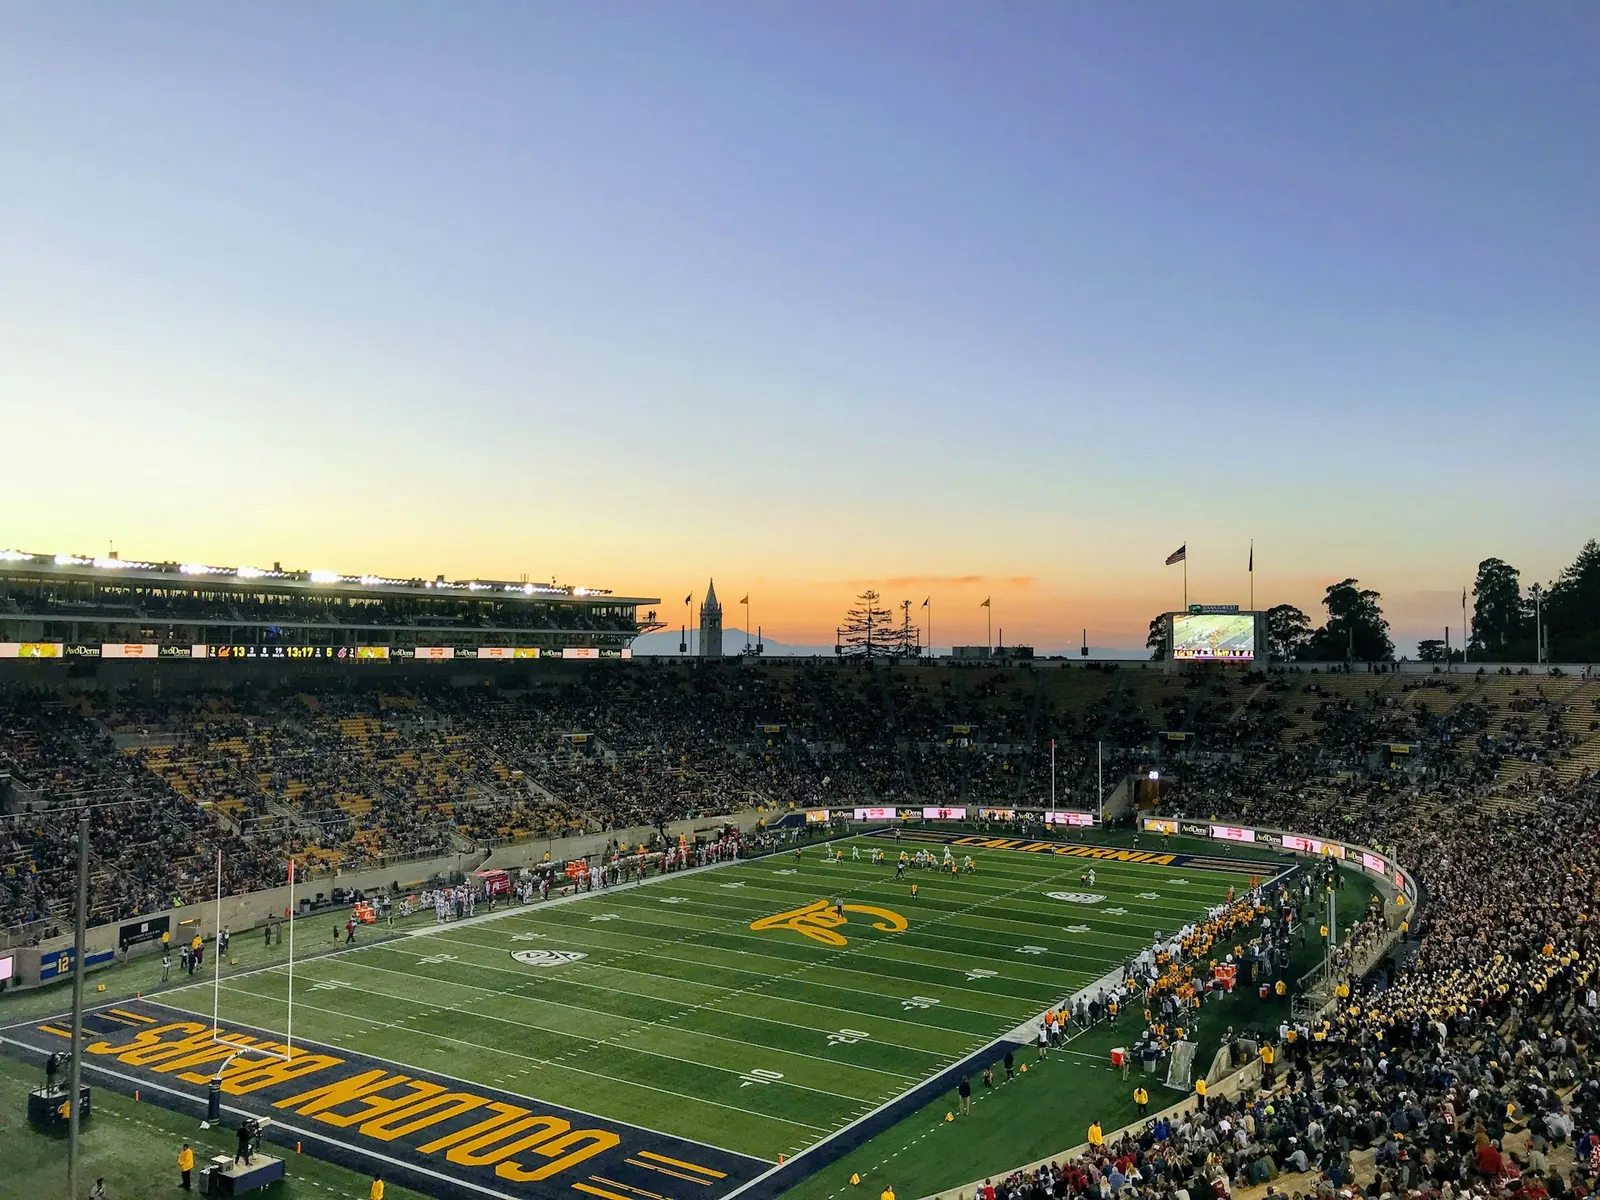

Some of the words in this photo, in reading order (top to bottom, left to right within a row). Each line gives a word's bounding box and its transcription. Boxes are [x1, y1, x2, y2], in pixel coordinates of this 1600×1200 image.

[65, 646, 99, 655] AvoDerm
[160, 646, 190, 655] AvoDerm
[232, 646, 246, 657] 13
[286, 647, 314, 657] 13:17
[326, 647, 332, 657] 5
[1181, 824, 1208, 836] AvoDerm
[1256, 832, 1281, 844] AvoDerm
[952, 837, 1176, 865] CALIFORNIA
[750, 899, 908, 946] Cal
[57, 956, 69, 973] 12
[826, 1028, 870, 1044] 20
[88, 1021, 345, 1096] BEARS
[739, 1068, 785, 1085] 10
[272, 1069, 621, 1183] GOLDEN
